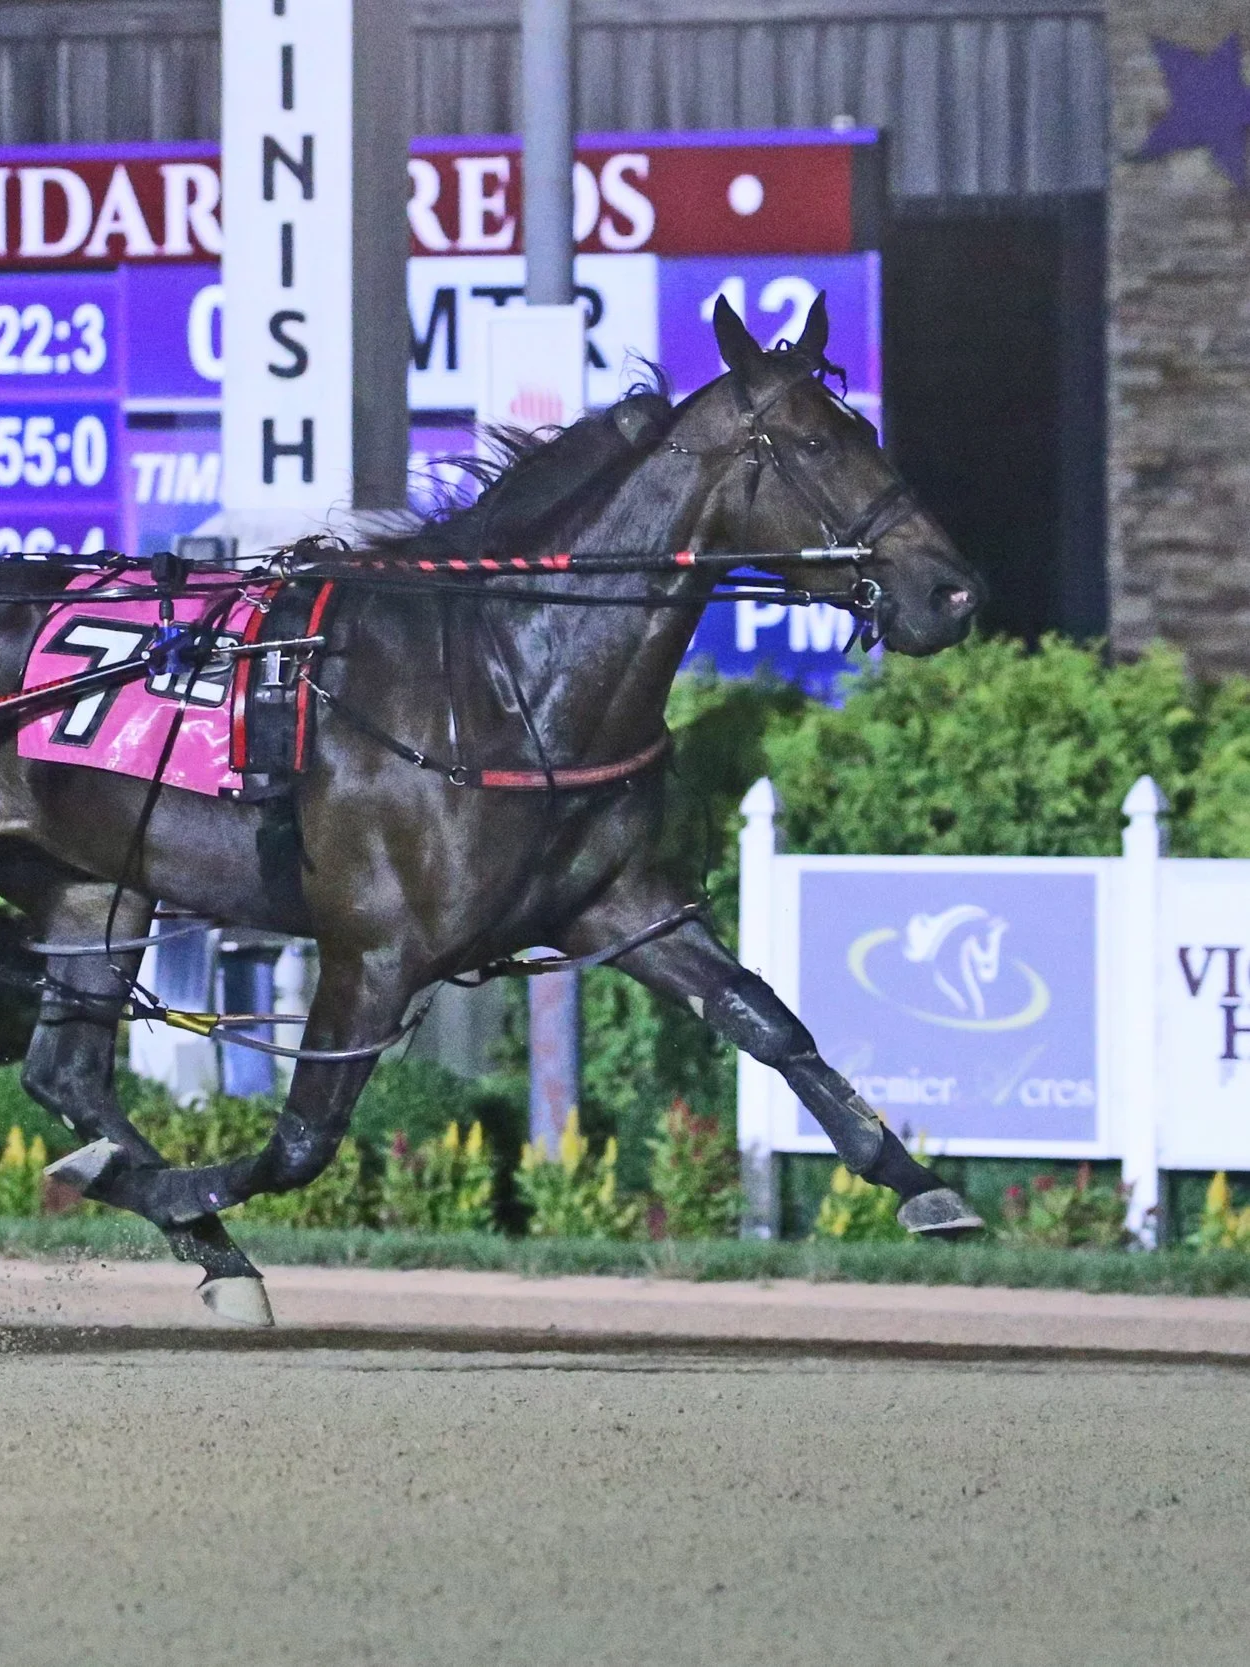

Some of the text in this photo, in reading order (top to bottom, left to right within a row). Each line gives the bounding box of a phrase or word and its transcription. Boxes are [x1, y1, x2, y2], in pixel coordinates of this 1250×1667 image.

[261, 0, 316, 484] INISH
[131, 452, 221, 503] TIM
[52, 619, 148, 744] 7
[1178, 946, 1250, 998] VI
